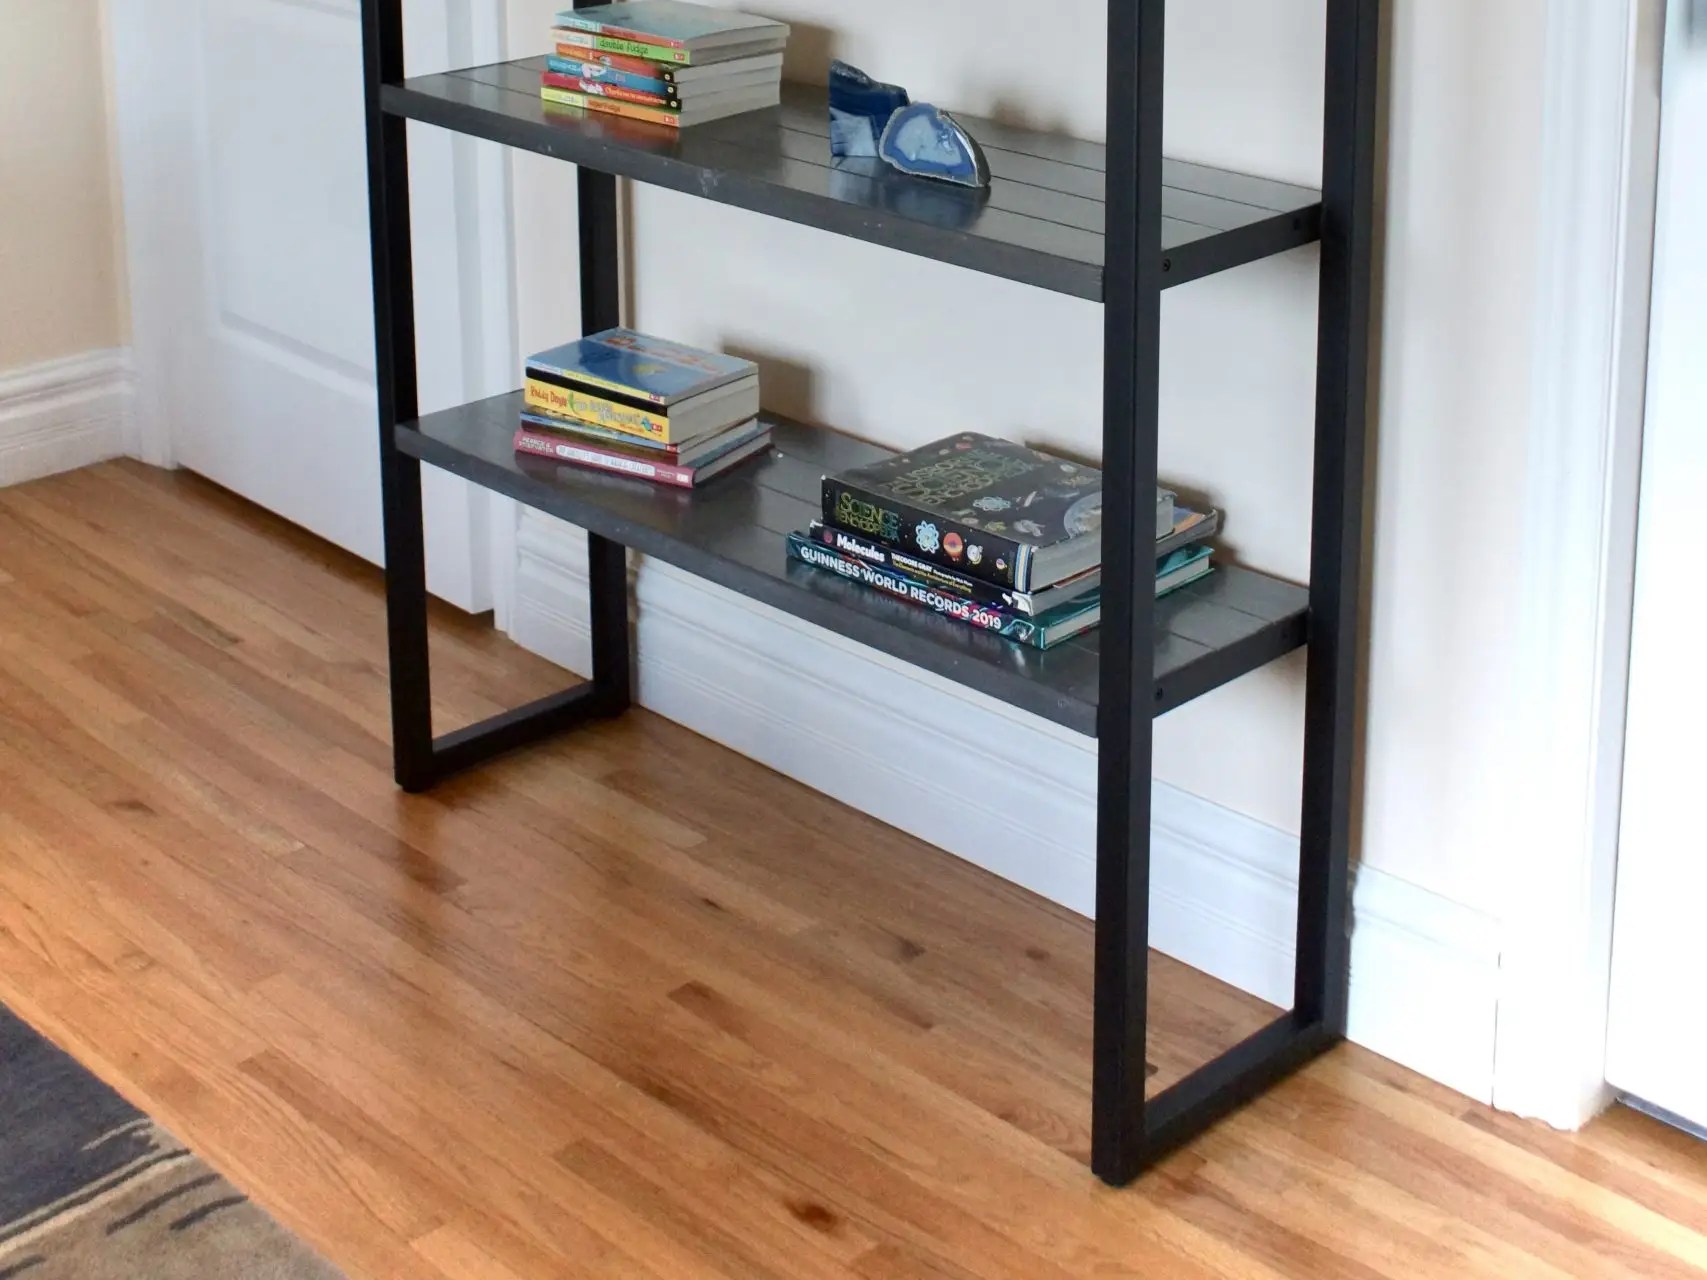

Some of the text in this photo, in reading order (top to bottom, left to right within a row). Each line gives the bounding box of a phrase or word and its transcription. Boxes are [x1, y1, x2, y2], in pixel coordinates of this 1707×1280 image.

[839, 491, 899, 526] SCIENCE
[836, 533, 885, 562] Molecules
[800, 546, 1001, 630] GUINNESS WORLD RECORDS 2019
